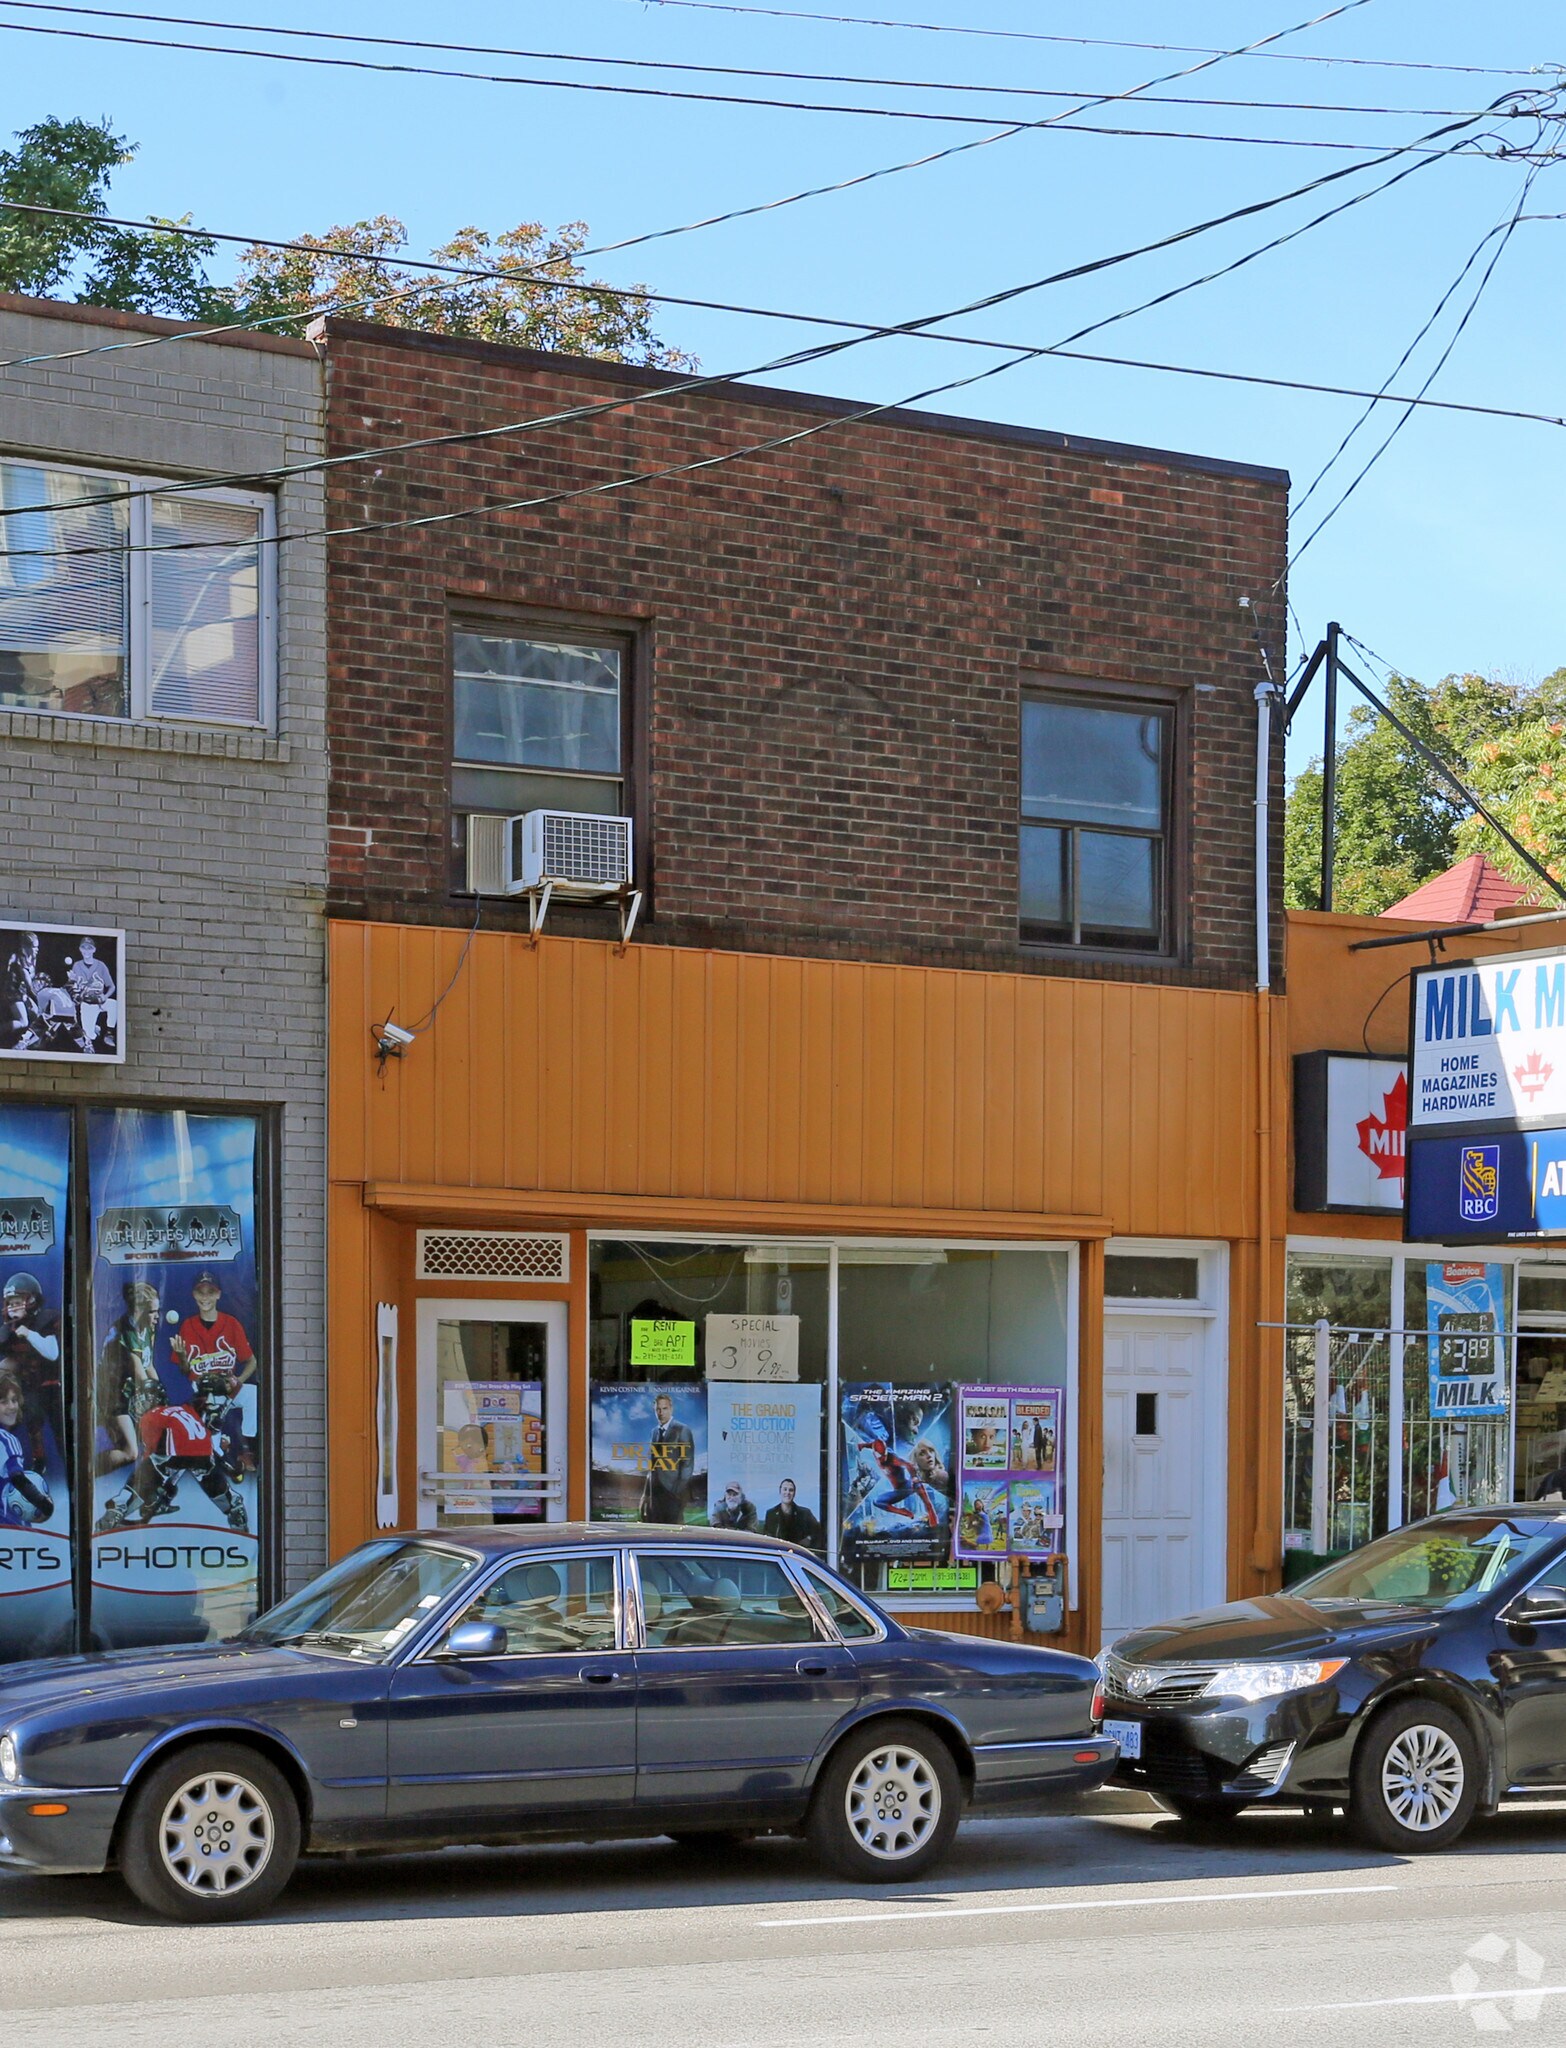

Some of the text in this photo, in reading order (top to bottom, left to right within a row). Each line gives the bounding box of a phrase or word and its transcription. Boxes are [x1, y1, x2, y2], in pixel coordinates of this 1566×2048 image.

[1424, 968, 1521, 1042] MILK
[1440, 1054, 1480, 1072] HOME
[1422, 1072, 1498, 1093] MAGAZINES
[1422, 1092, 1496, 1112] HARDWARE
[1464, 1198, 1494, 1215] RBC
[0, 1219, 50, 1234] IMAGE
[104, 1226, 239, 1244] ATHLETES IMAGE
[124, 1251, 158, 1260] SPORTS
[1446, 1266, 1481, 1276] Beatrice
[653, 1320, 677, 1332] RENT
[731, 1319, 781, 1332] SPECIAL
[640, 1334, 650, 1348] 2
[666, 1334, 687, 1348] APT
[850, 1393, 943, 1402] SPIDER-MAN 2
[1437, 1381, 1498, 1407] MILK
[731, 1403, 796, 1417] THE GRAND
[1016, 1405, 1050, 1416] BLENDED
[730, 1417, 796, 1431] SEDUCTION
[731, 1431, 795, 1444] WELCOME
[611, 1444, 691, 1459] DRAFT
[637, 1458, 682, 1472] DAY
[97, 1546, 249, 1569] PHOTOS
